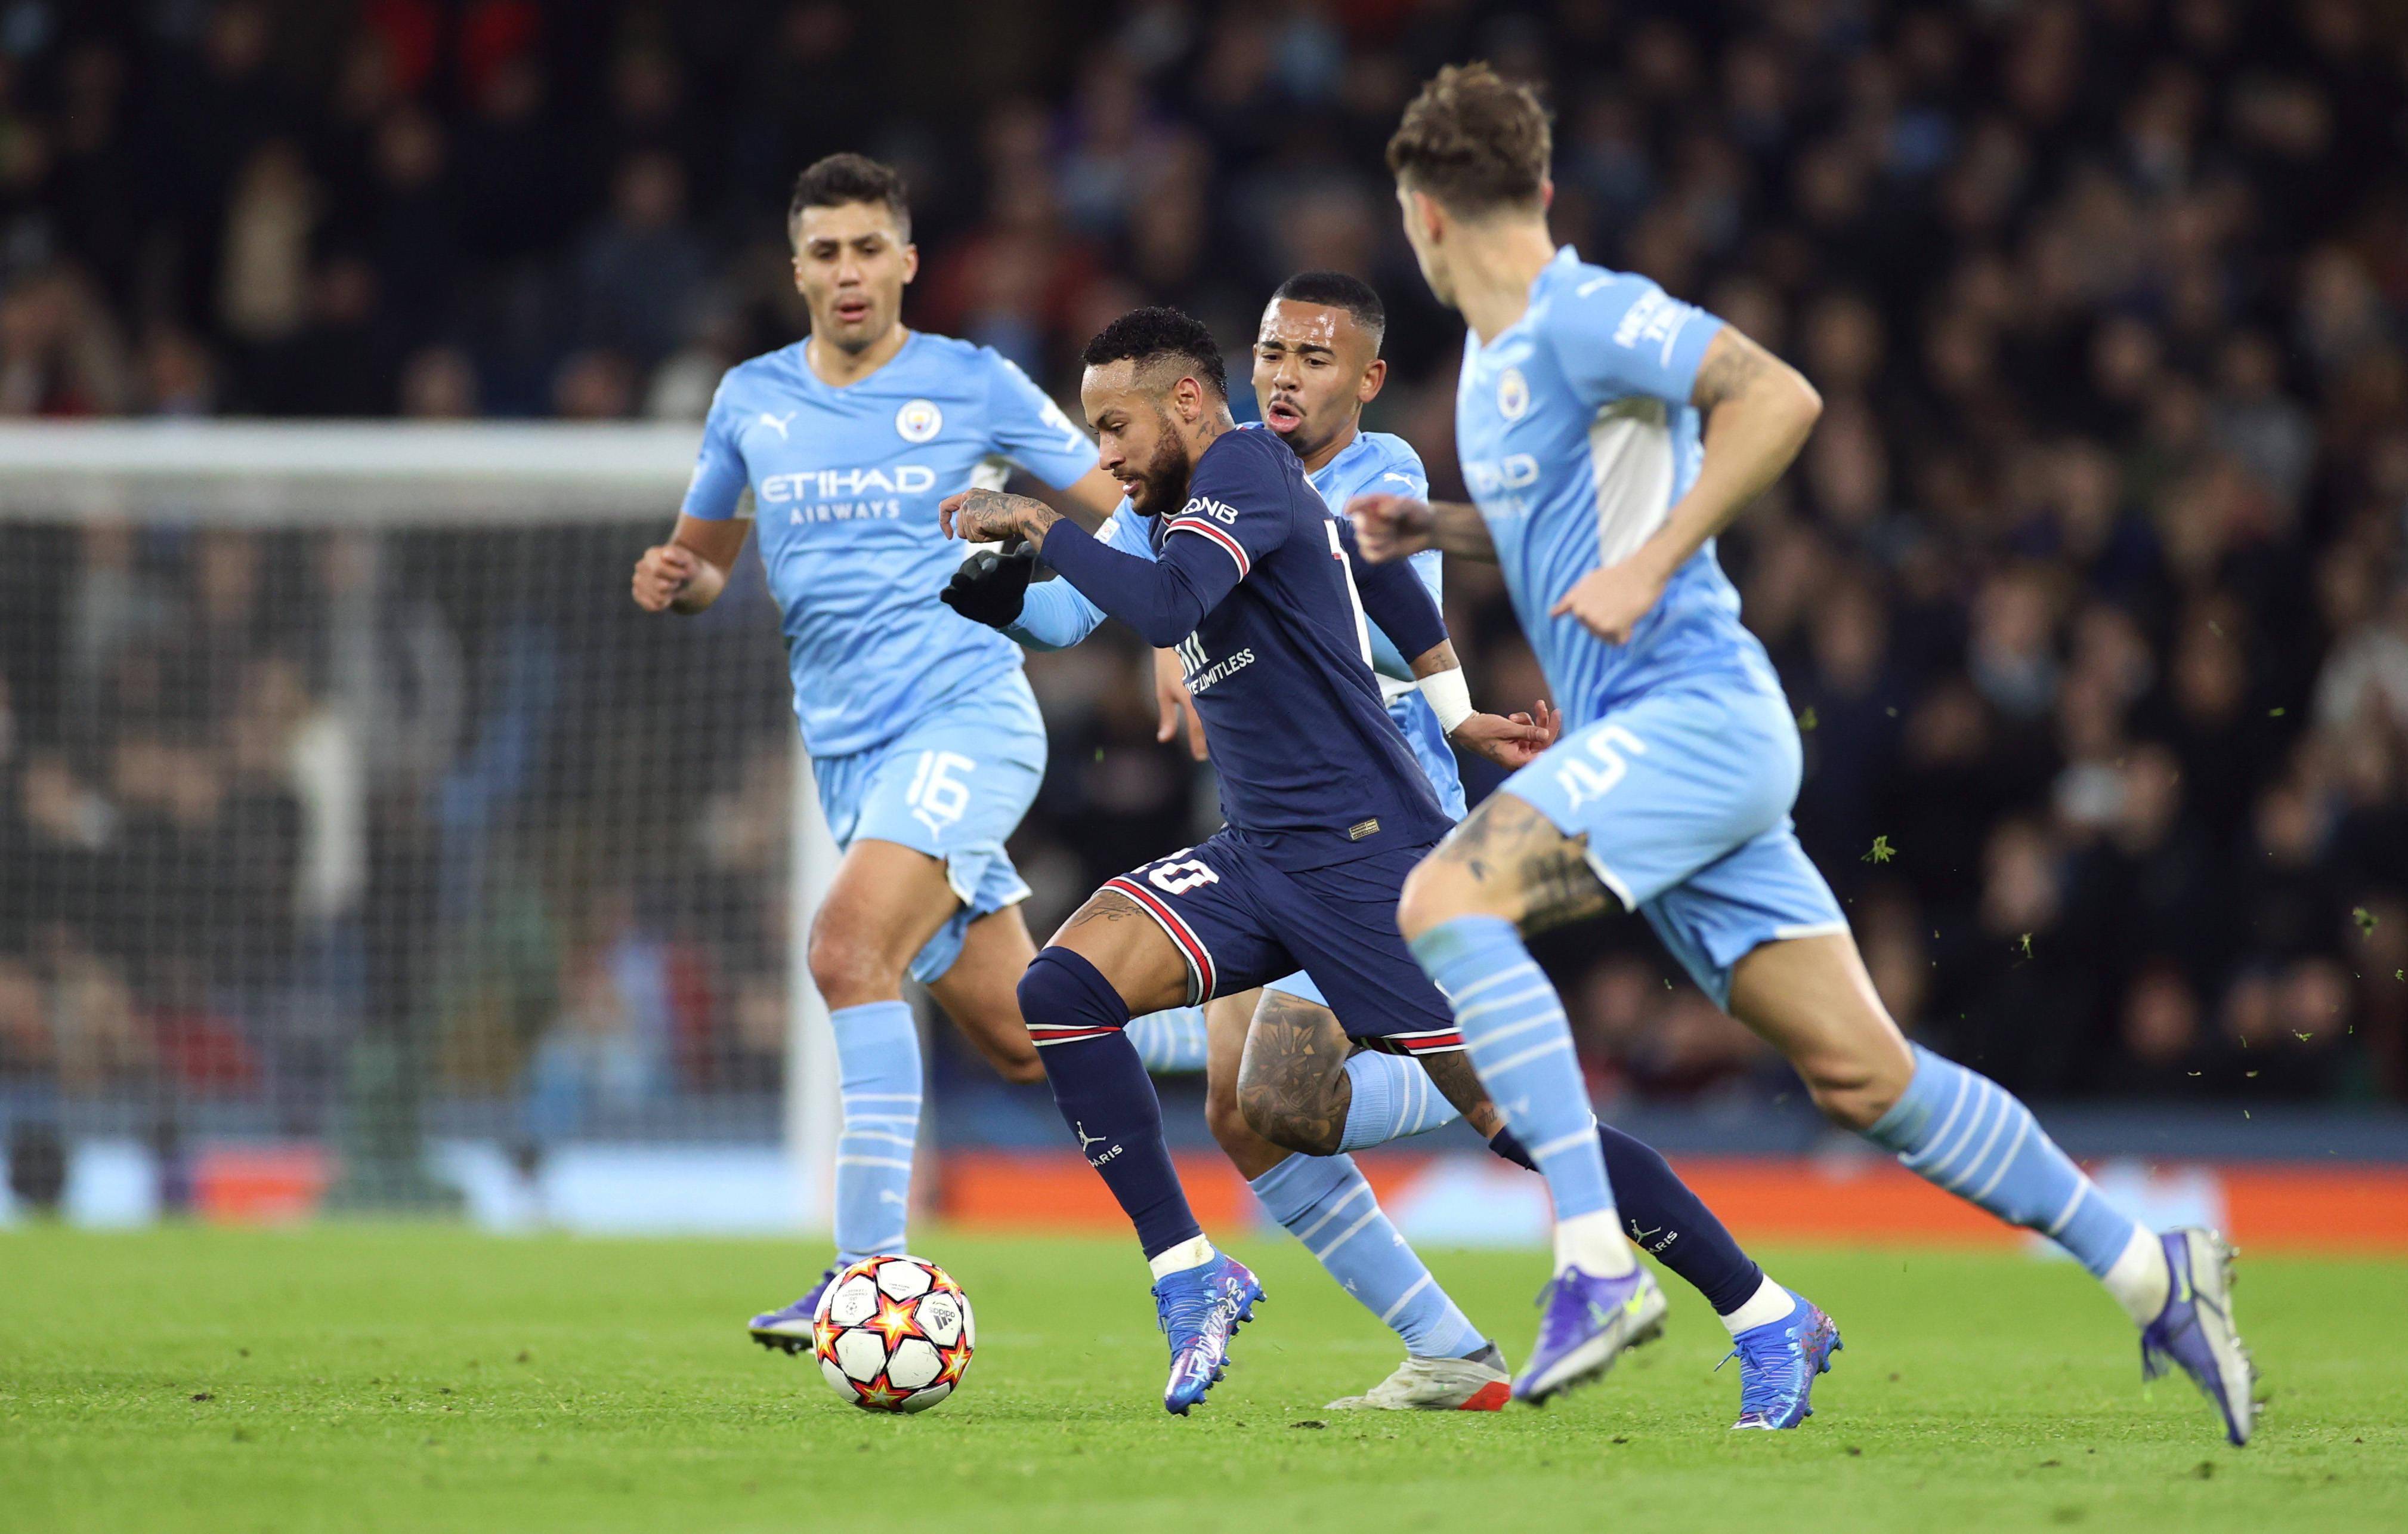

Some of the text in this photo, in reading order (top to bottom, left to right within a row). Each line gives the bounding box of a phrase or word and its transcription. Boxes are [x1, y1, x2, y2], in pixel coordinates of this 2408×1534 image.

[761, 465, 936, 503] ETIHAD
[790, 499, 900, 525] AIRWAYS
[1181, 496, 1238, 524] QNB
[1200, 648, 1255, 692] LIMITLESS
[905, 750, 978, 822] 16
[1648, 1230, 1678, 1254] ARIS
[929, 1307, 956, 1318] adidas
